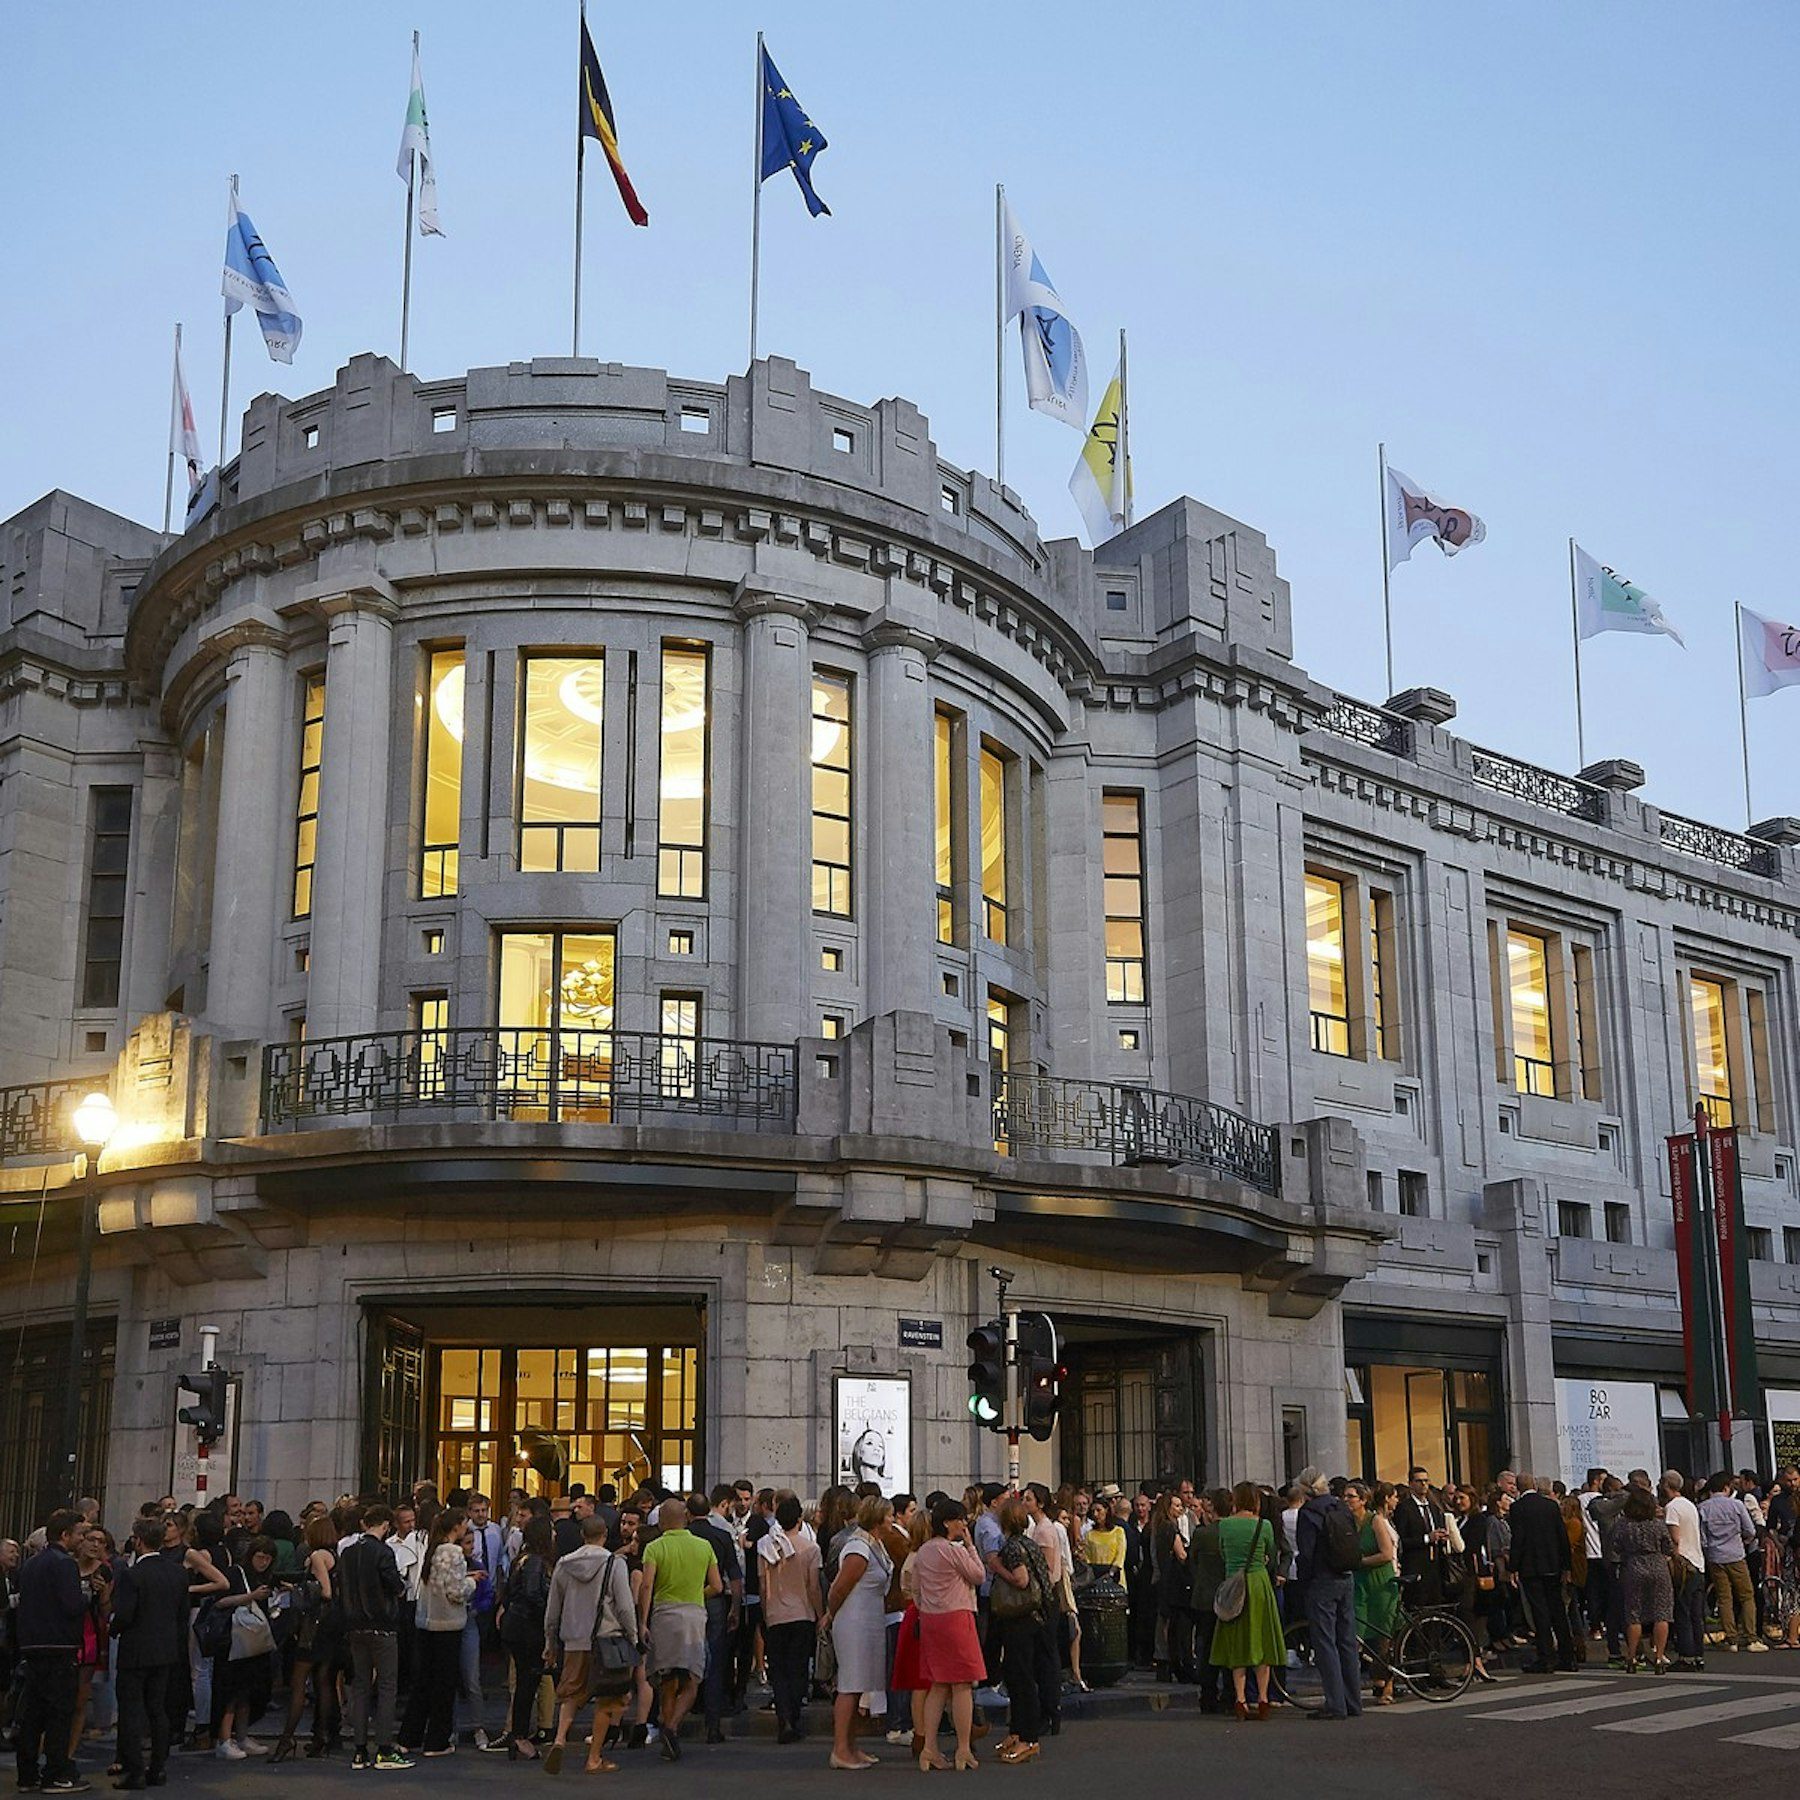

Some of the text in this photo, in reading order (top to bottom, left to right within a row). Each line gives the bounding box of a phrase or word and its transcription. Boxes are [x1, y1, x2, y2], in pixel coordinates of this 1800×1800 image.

[903, 1331, 940, 1340] RAVENSTEIN
[846, 1396, 866, 1408] THE
[844, 1408, 898, 1421] BELGIANS
[1588, 1405, 1611, 1420] ZAR
[1570, 1439, 1593, 1451] 2015
